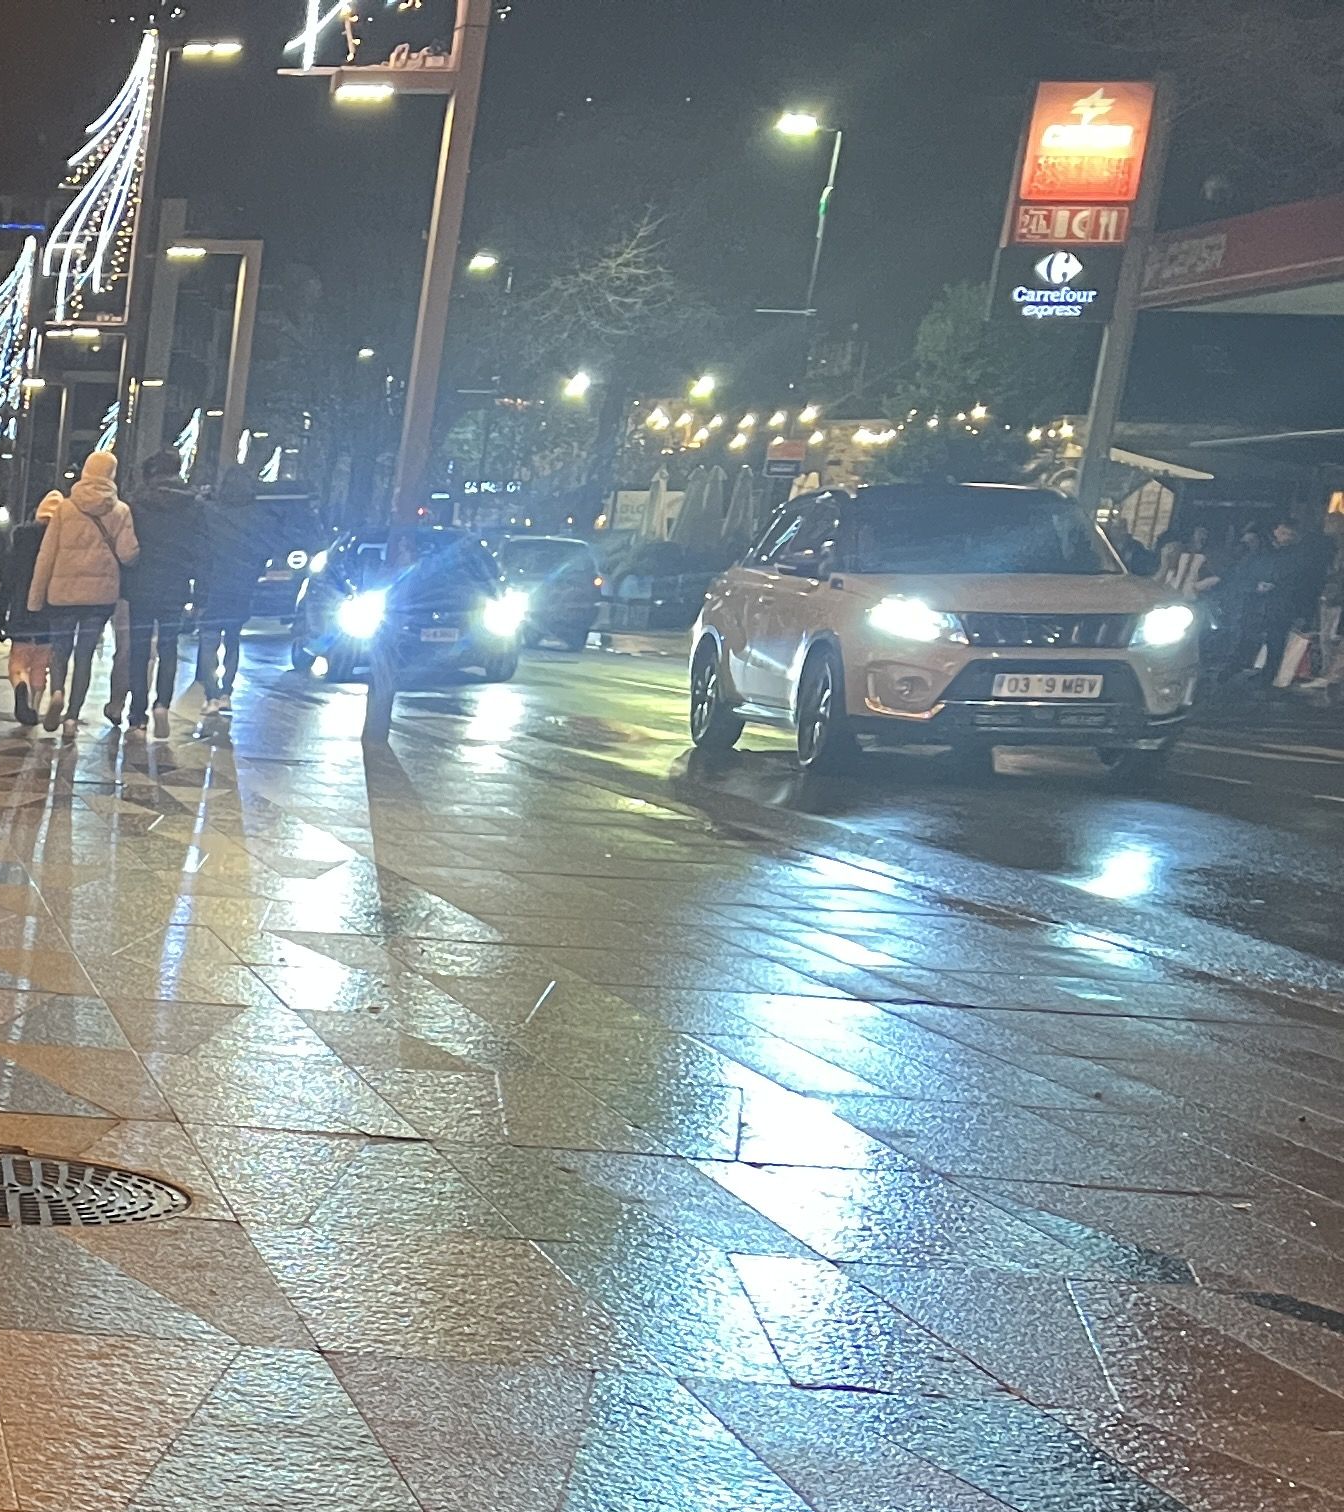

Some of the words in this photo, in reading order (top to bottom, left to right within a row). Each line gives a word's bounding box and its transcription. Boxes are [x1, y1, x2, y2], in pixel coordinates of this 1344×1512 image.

[1013, 286, 1097, 303] Carrefour
[1022, 305, 1082, 319] express
[1007, 677, 1056, 693] 039
